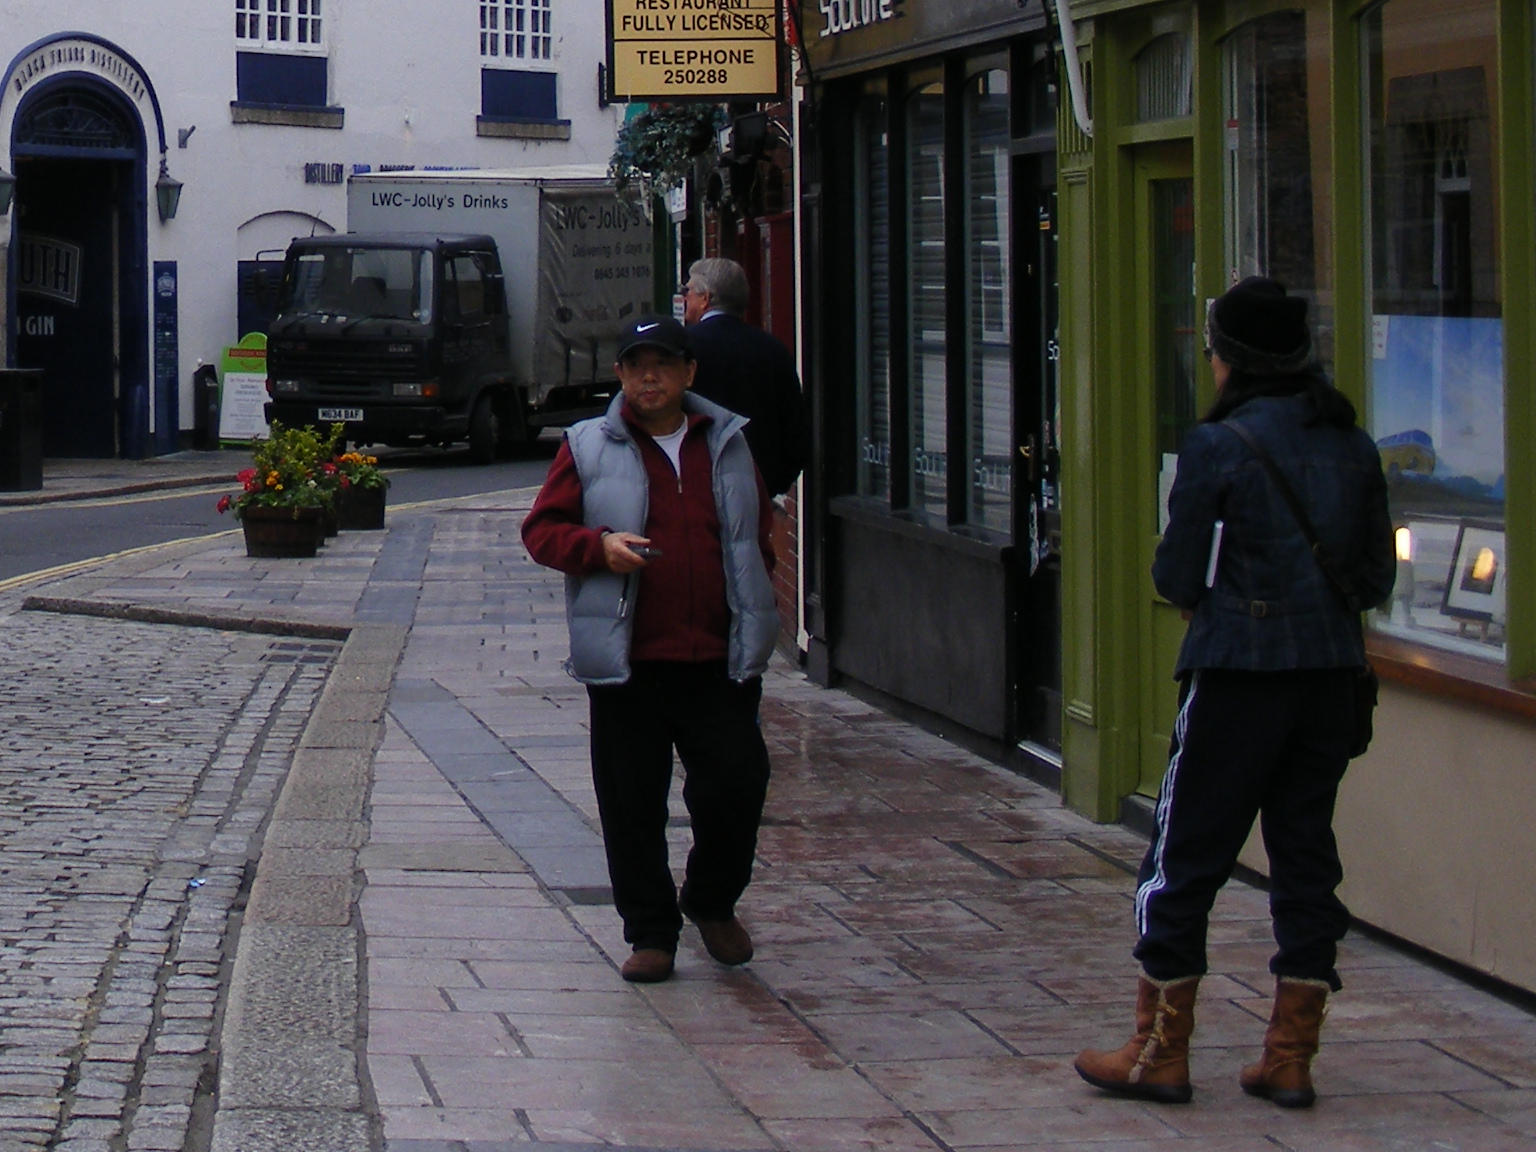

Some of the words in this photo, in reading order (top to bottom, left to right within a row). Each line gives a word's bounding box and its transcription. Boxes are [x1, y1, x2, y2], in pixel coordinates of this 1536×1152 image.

[622, 15, 675, 31] FULLY
[682, 14, 767, 31] LICENSED
[637, 49, 754, 65] TELEPHONE
[664, 69, 728, 84] 250288
[372, 192, 454, 210] LWC-Jolly's
[464, 193, 508, 209] Drinks
[25, 315, 54, 336] GIN
